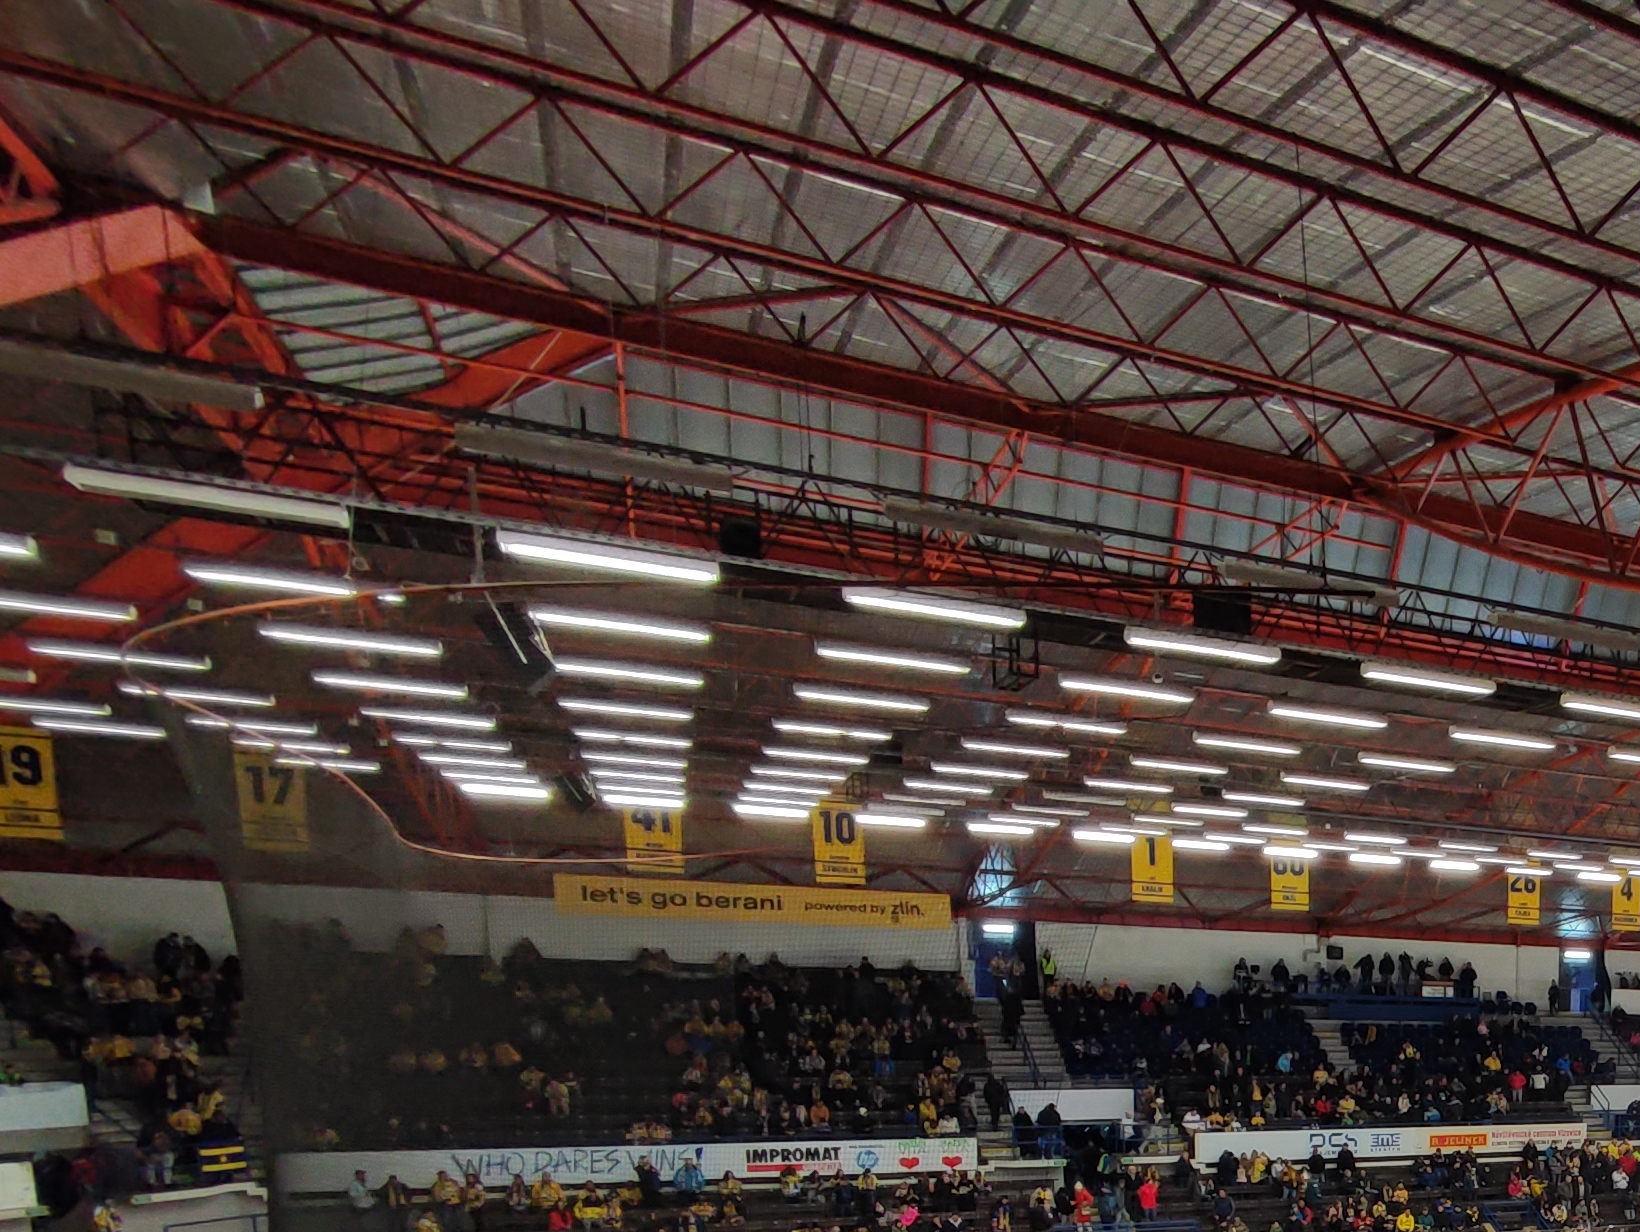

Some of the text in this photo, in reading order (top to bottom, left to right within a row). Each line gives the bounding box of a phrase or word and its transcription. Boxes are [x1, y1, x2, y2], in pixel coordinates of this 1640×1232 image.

[246, 766, 295, 804] 17
[820, 810, 856, 845] 10
[1510, 876, 1536, 893] 26
[1620, 878, 1633, 900] 4
[582, 886, 643, 904] let's
[652, 891, 687, 910] go
[695, 890, 784, 912] berani
[804, 902, 866, 914] powered
[870, 904, 886, 915] by
[452, 1151, 525, 1183] WHO
[533, 1148, 621, 1176] DARES
[745, 1147, 842, 1165] IMPROMAT
